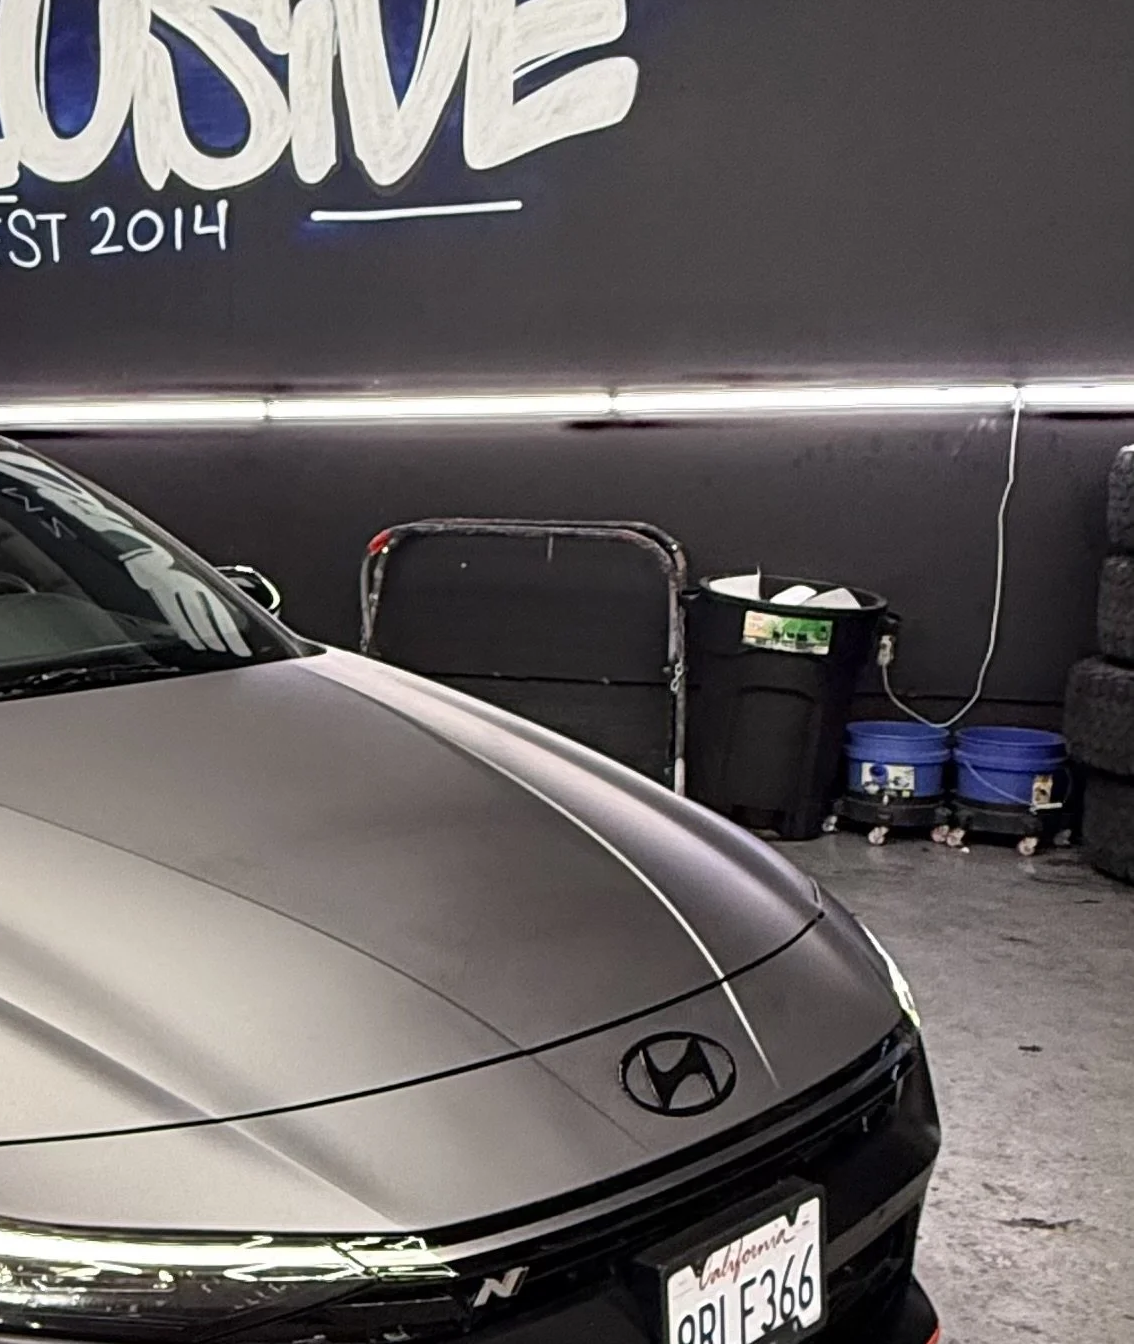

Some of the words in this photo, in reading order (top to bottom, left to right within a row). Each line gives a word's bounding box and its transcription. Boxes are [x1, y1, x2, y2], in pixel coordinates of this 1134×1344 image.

[89, 199, 229, 255] 2014
[473, 1265, 530, 1308] N
[697, 1226, 796, 1291] California
